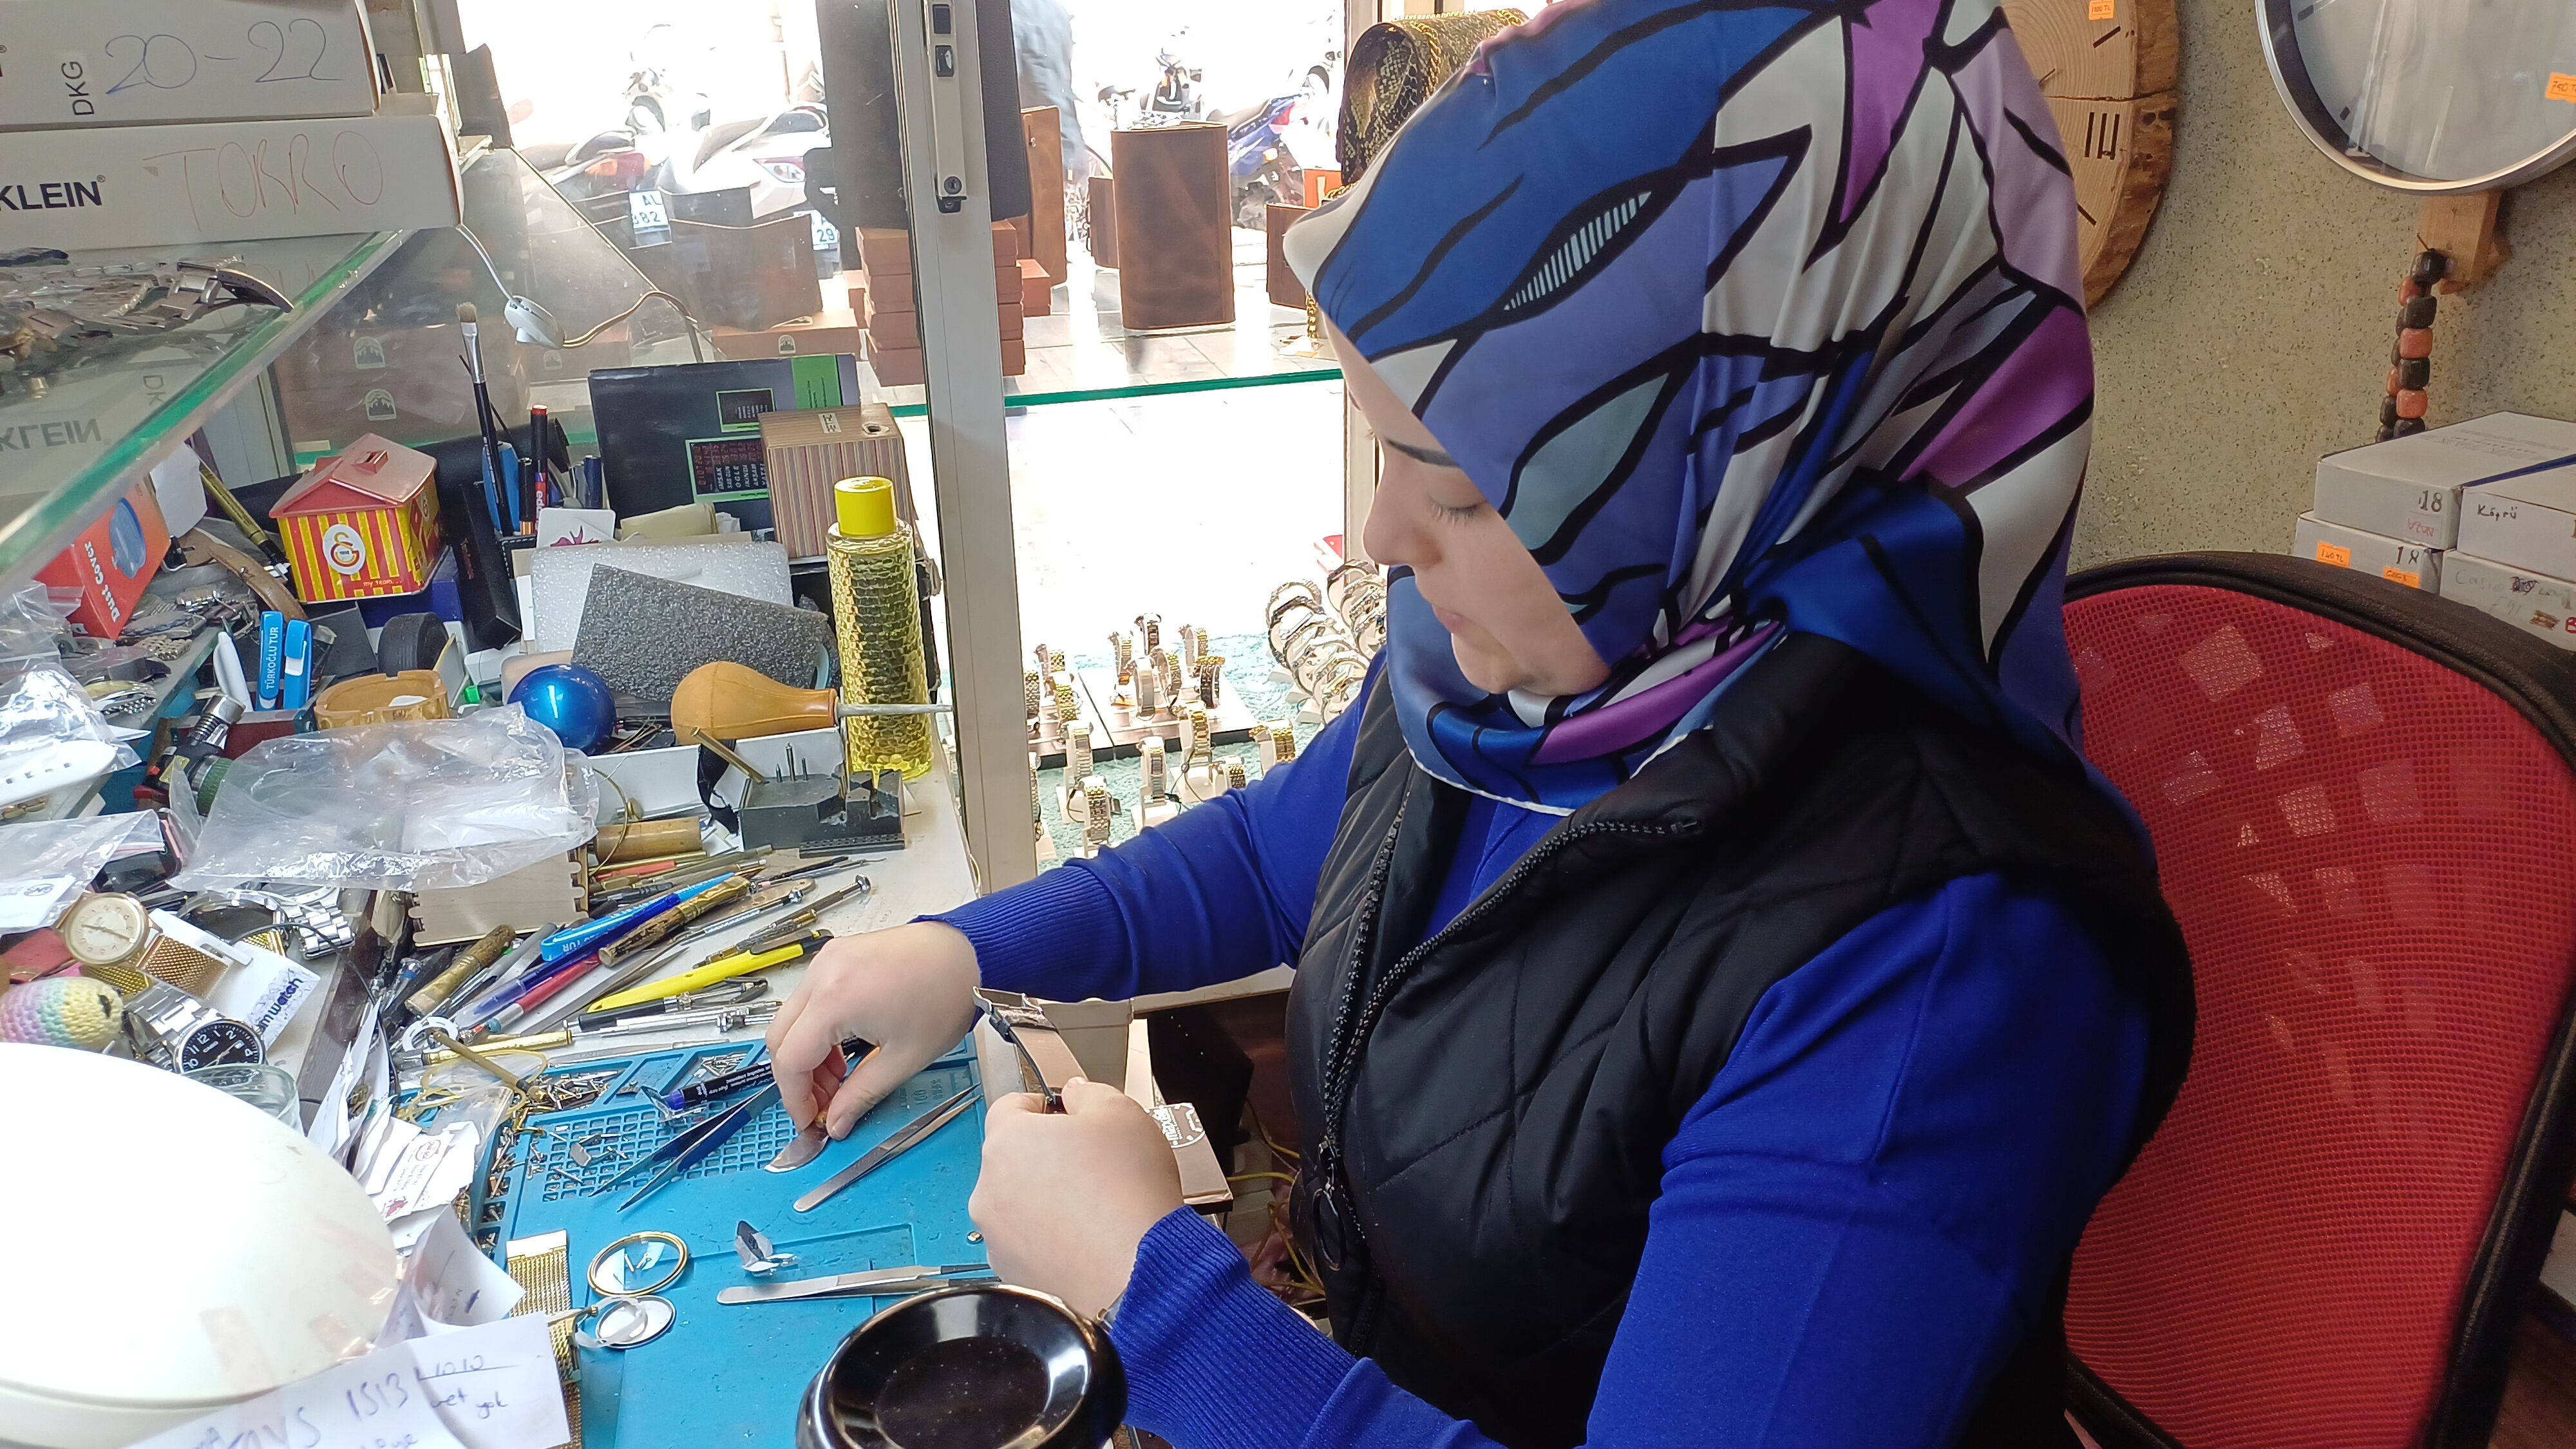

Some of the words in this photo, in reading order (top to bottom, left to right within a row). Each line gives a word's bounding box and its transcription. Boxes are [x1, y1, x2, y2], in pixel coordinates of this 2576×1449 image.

[61, 61, 95, 115] DKG
[269, 627, 279, 645] TUR
[264, 646, 278, 690] TÜRKOĞLU
[197, 1034, 210, 1045] 12
[226, 1030, 237, 1040] 2
[186, 1045, 200, 1055] 11
